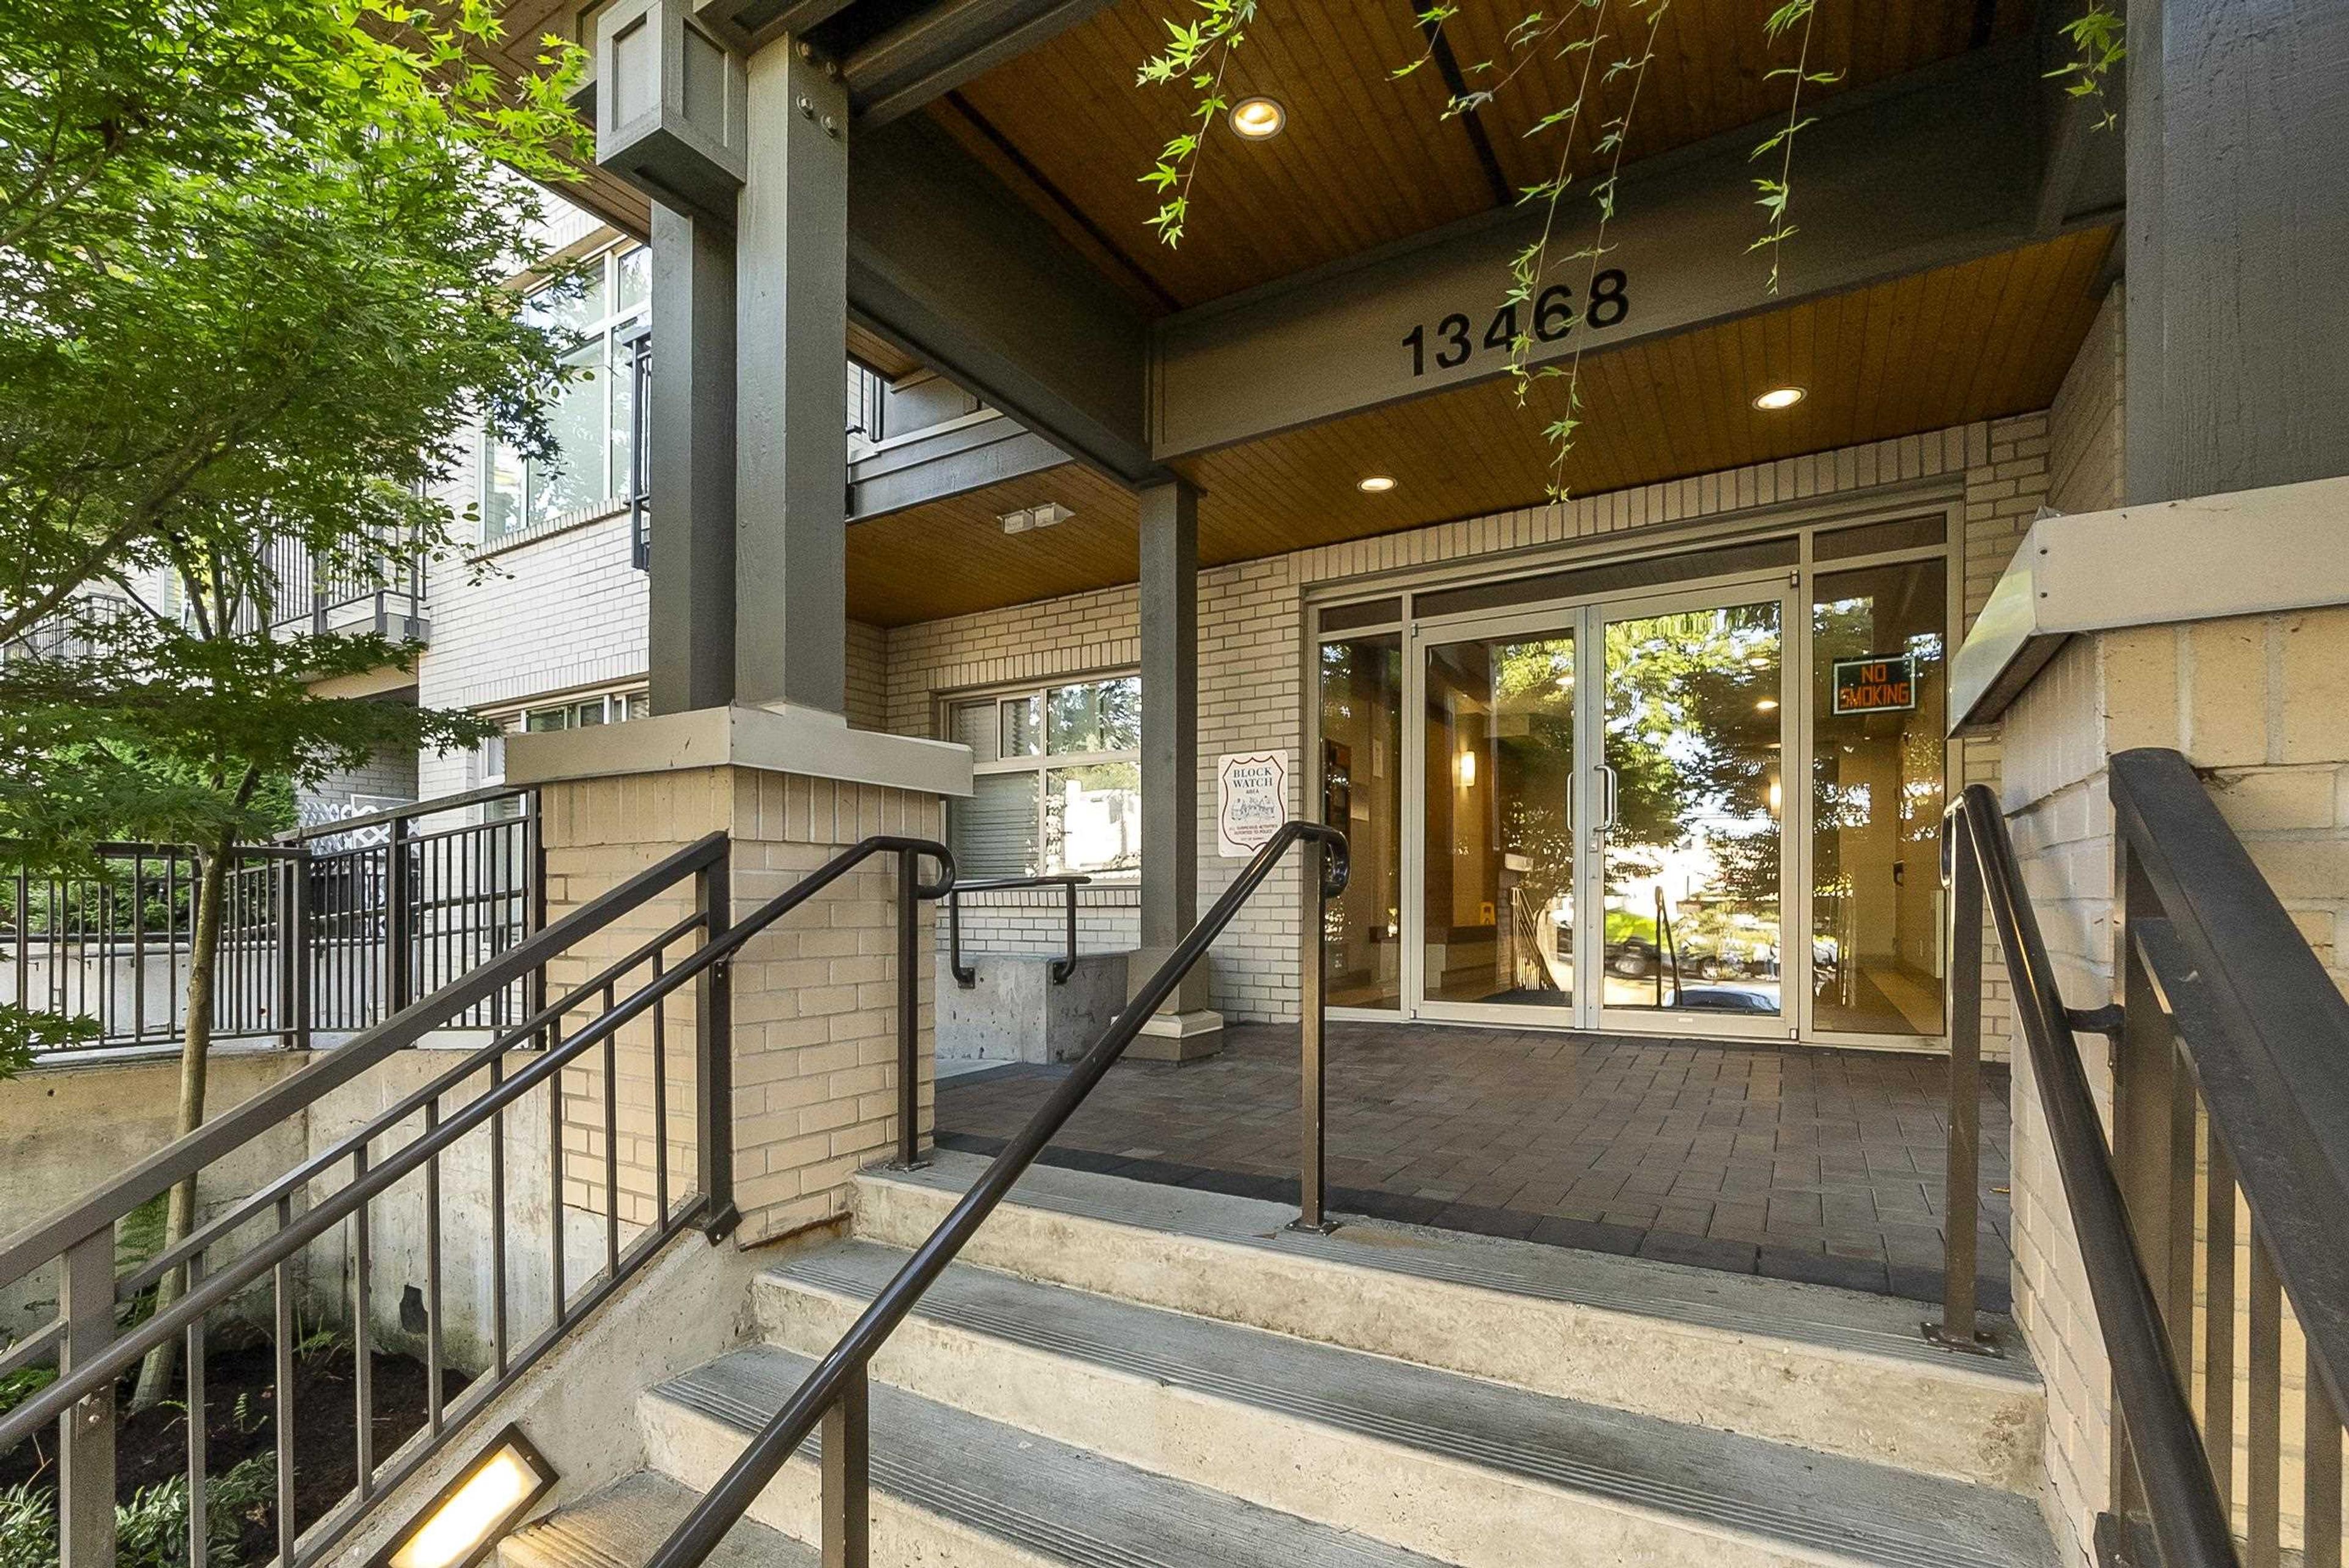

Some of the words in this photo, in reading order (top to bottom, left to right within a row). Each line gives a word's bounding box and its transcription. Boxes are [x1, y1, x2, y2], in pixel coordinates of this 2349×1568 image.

[1401, 268, 1629, 377] 13468
[1861, 664, 1887, 683] NO
[1839, 682, 1909, 709] SMOKING
[1233, 767, 1272, 778] BLOCK
[1233, 777, 1272, 788] WATCH
